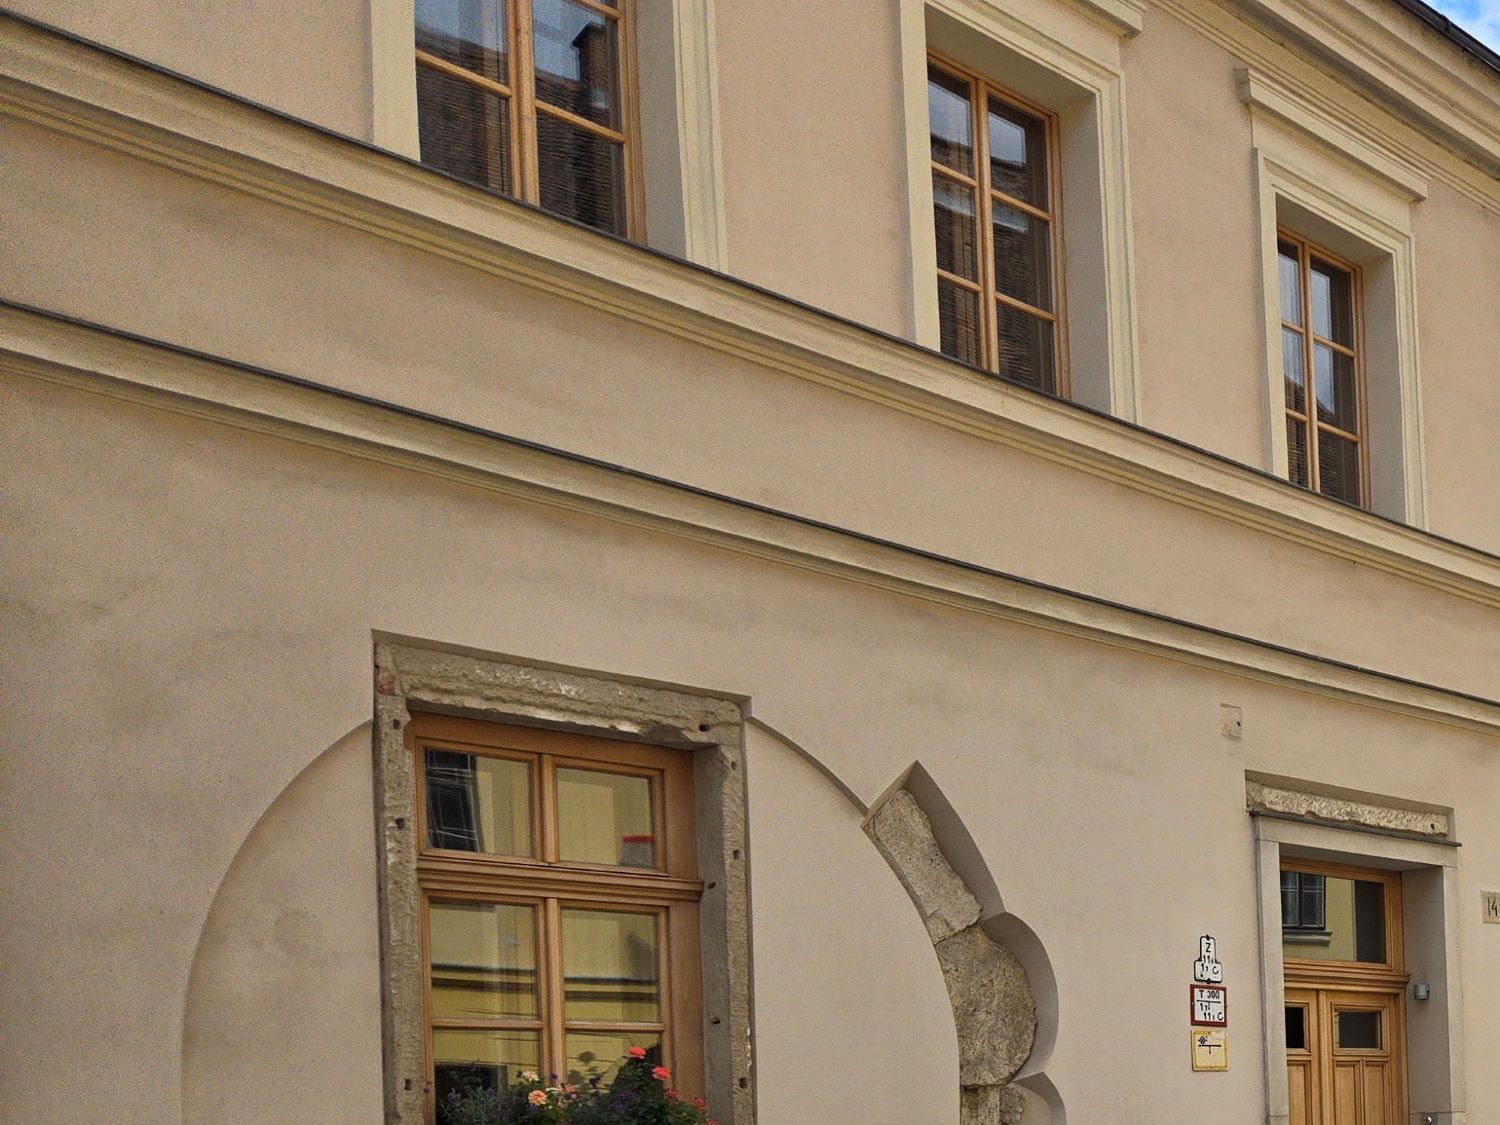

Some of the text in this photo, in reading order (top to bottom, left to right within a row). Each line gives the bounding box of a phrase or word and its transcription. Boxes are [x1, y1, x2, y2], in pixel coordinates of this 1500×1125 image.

[1487, 896, 1498, 917] 14
[1206, 942, 1211, 953] Z
[1199, 989, 1220, 999] T 300
